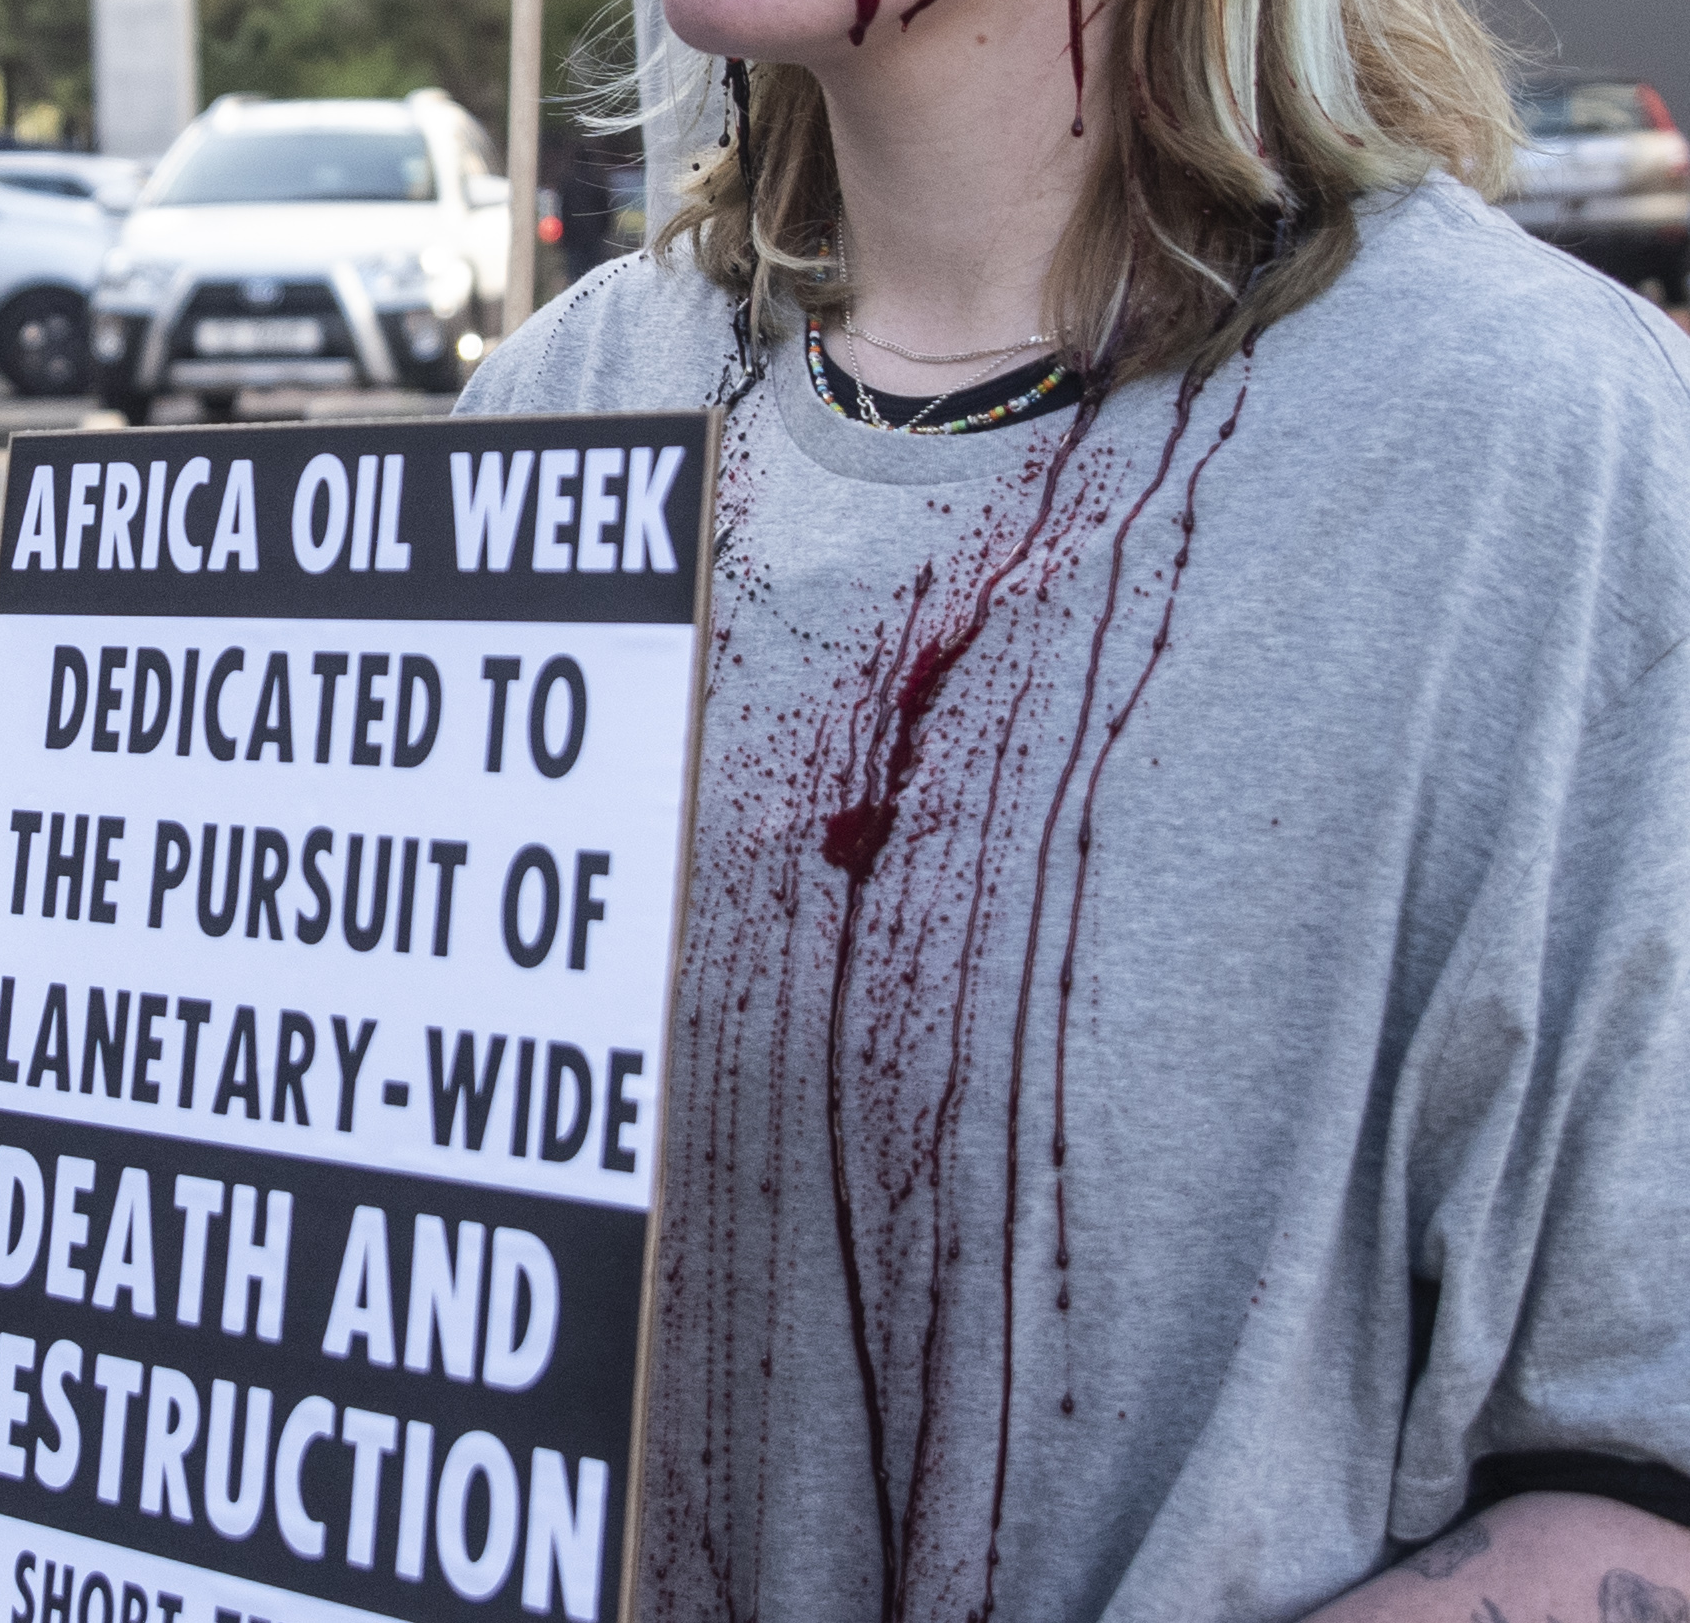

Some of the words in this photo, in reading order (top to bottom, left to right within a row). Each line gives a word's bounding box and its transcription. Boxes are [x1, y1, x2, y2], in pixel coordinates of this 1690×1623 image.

[11, 456, 259, 574] AFRICA
[292, 452, 412, 575] OIL
[450, 446, 687, 574] WEEK
[44, 645, 442, 769] DEDICATED
[482, 653, 587, 779] TO
[10, 809, 125, 924] THE
[148, 820, 468, 958] PURSUIT
[502, 843, 612, 970] OF
[322, 1205, 560, 1392] AND
